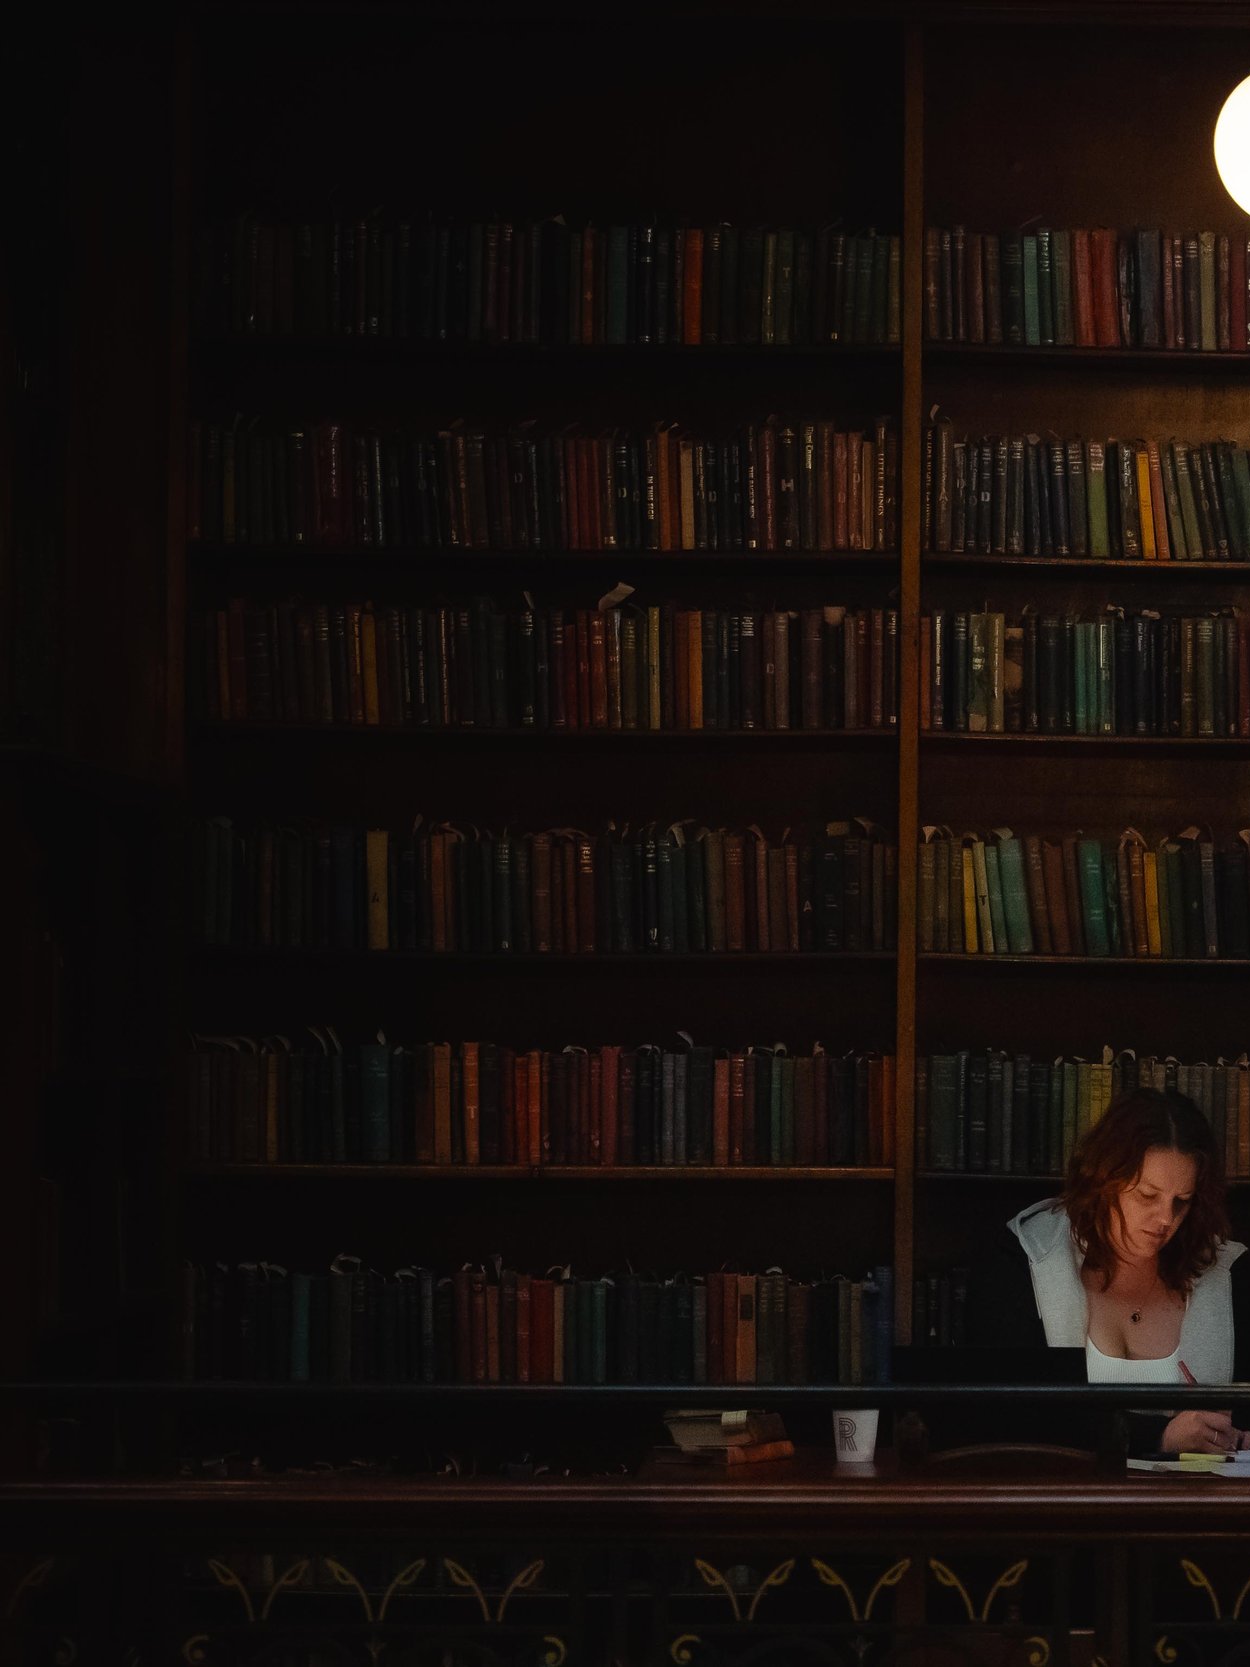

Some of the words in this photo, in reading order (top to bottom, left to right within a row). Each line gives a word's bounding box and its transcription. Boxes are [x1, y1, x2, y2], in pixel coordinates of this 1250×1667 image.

[781, 479, 794, 491] H
[981, 492, 991, 502] D
[803, 900, 812, 912] A
[839, 1417, 858, 1451] R
